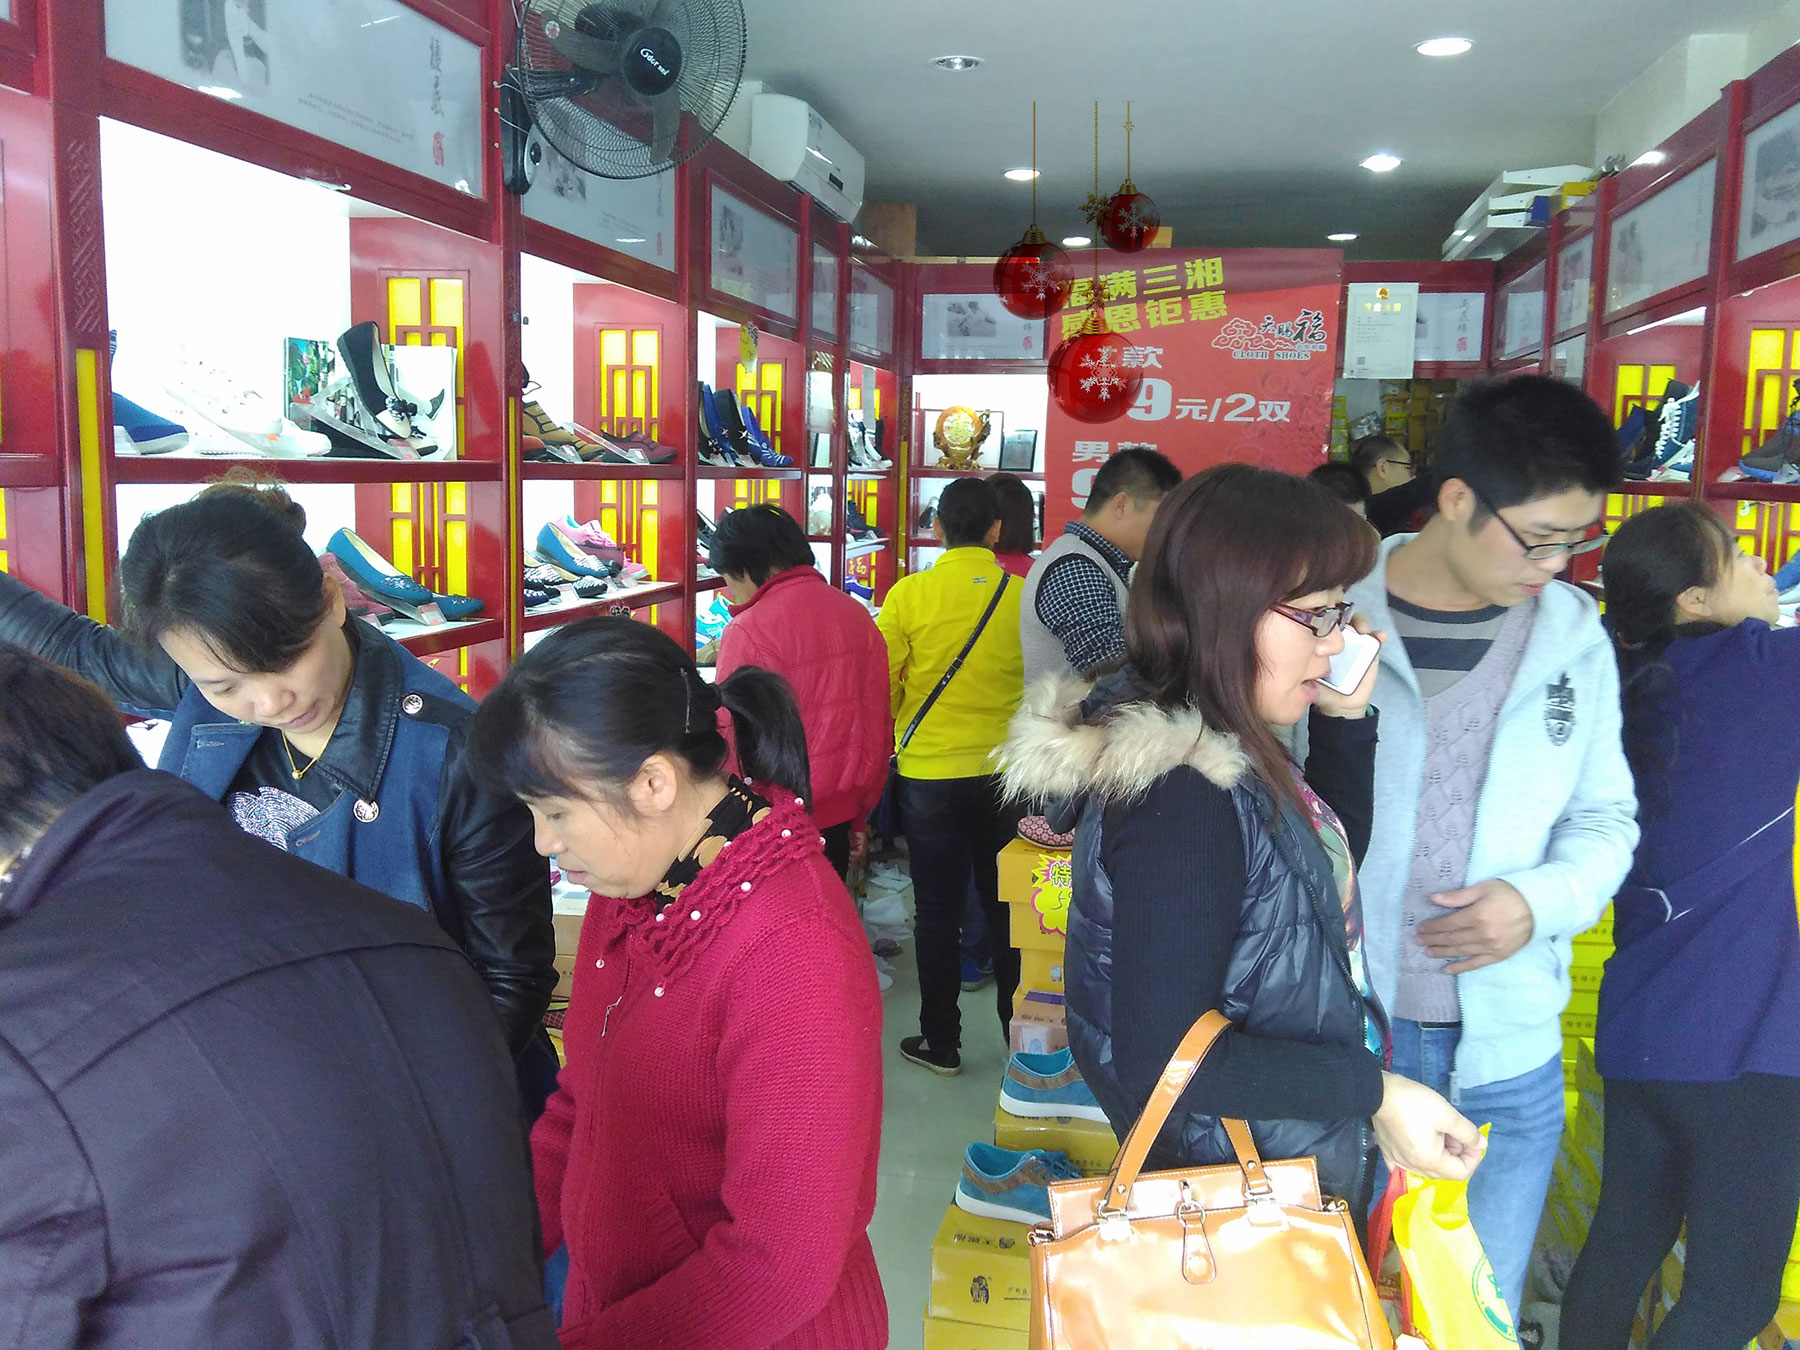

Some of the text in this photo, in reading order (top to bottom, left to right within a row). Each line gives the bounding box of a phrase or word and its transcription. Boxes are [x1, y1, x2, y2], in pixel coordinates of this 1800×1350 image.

[1233, 350, 1310, 359] CLOTH SHOES
[1126, 378, 1291, 423] 9元/2双
[1072, 441, 1157, 463] 男
